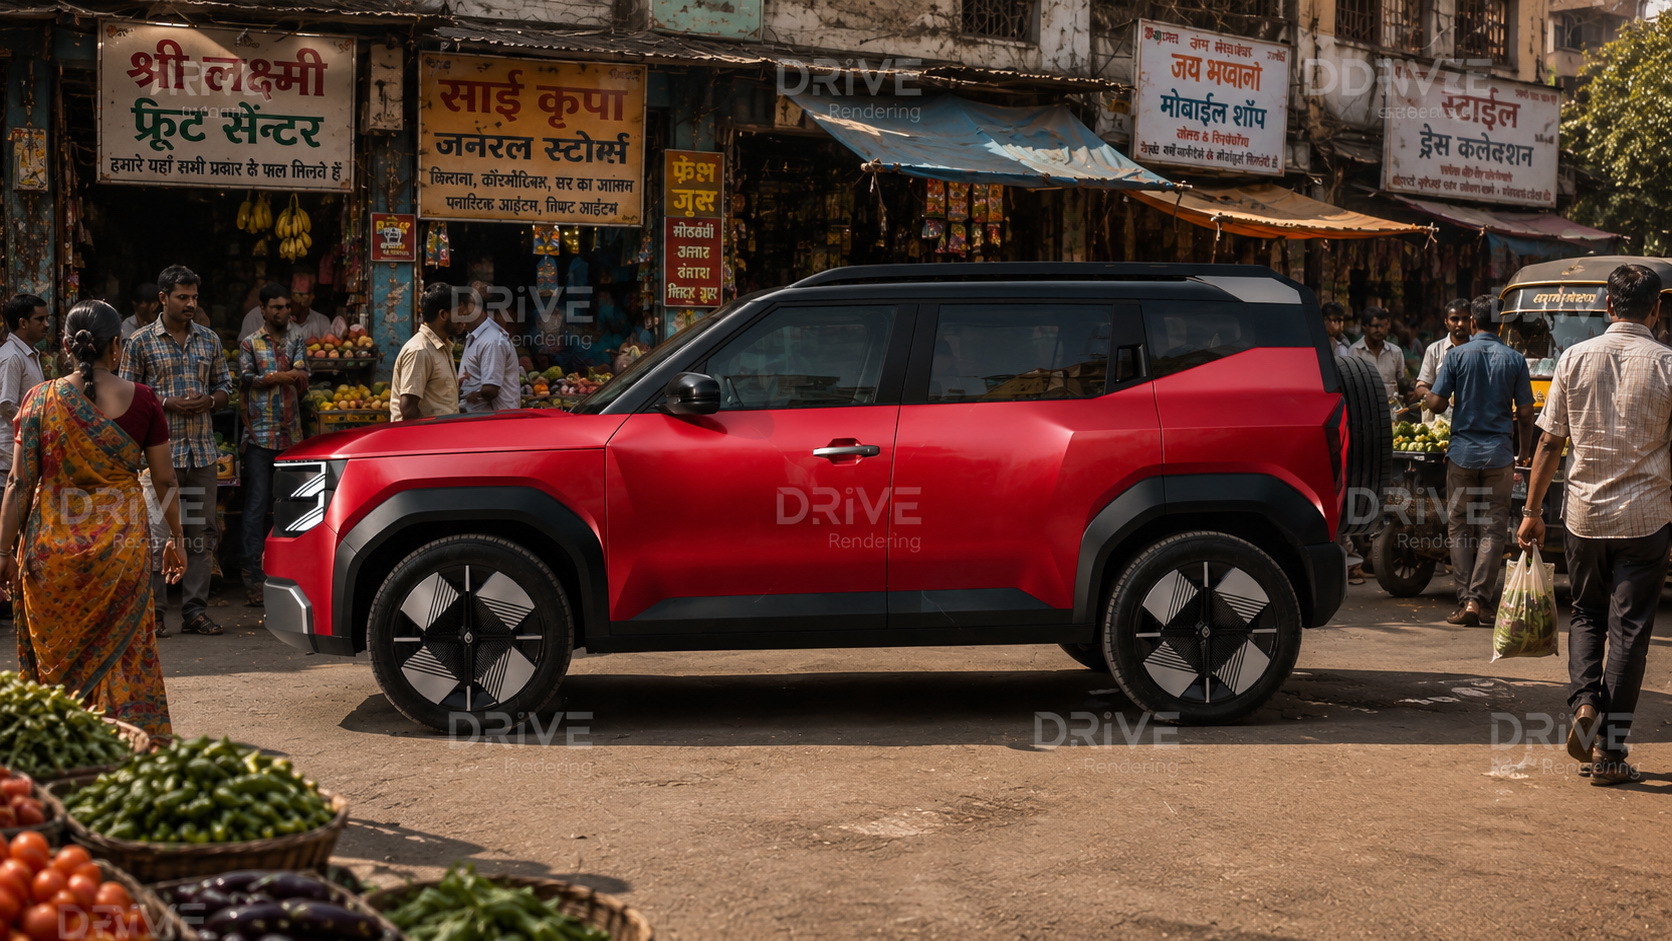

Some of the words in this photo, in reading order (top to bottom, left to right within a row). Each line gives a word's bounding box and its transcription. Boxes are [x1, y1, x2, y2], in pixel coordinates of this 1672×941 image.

[127, 39, 189, 89] श्री
[203, 48, 328, 101] लक्ष्मी
[1171, 53, 1202, 83] जय
[438, 69, 524, 122] साई
[536, 85, 628, 129] कृपा
[1160, 88, 1228, 127] मोबाईल
[1233, 99, 1267, 129] शॉप
[434, 132, 534, 160] जनरल
